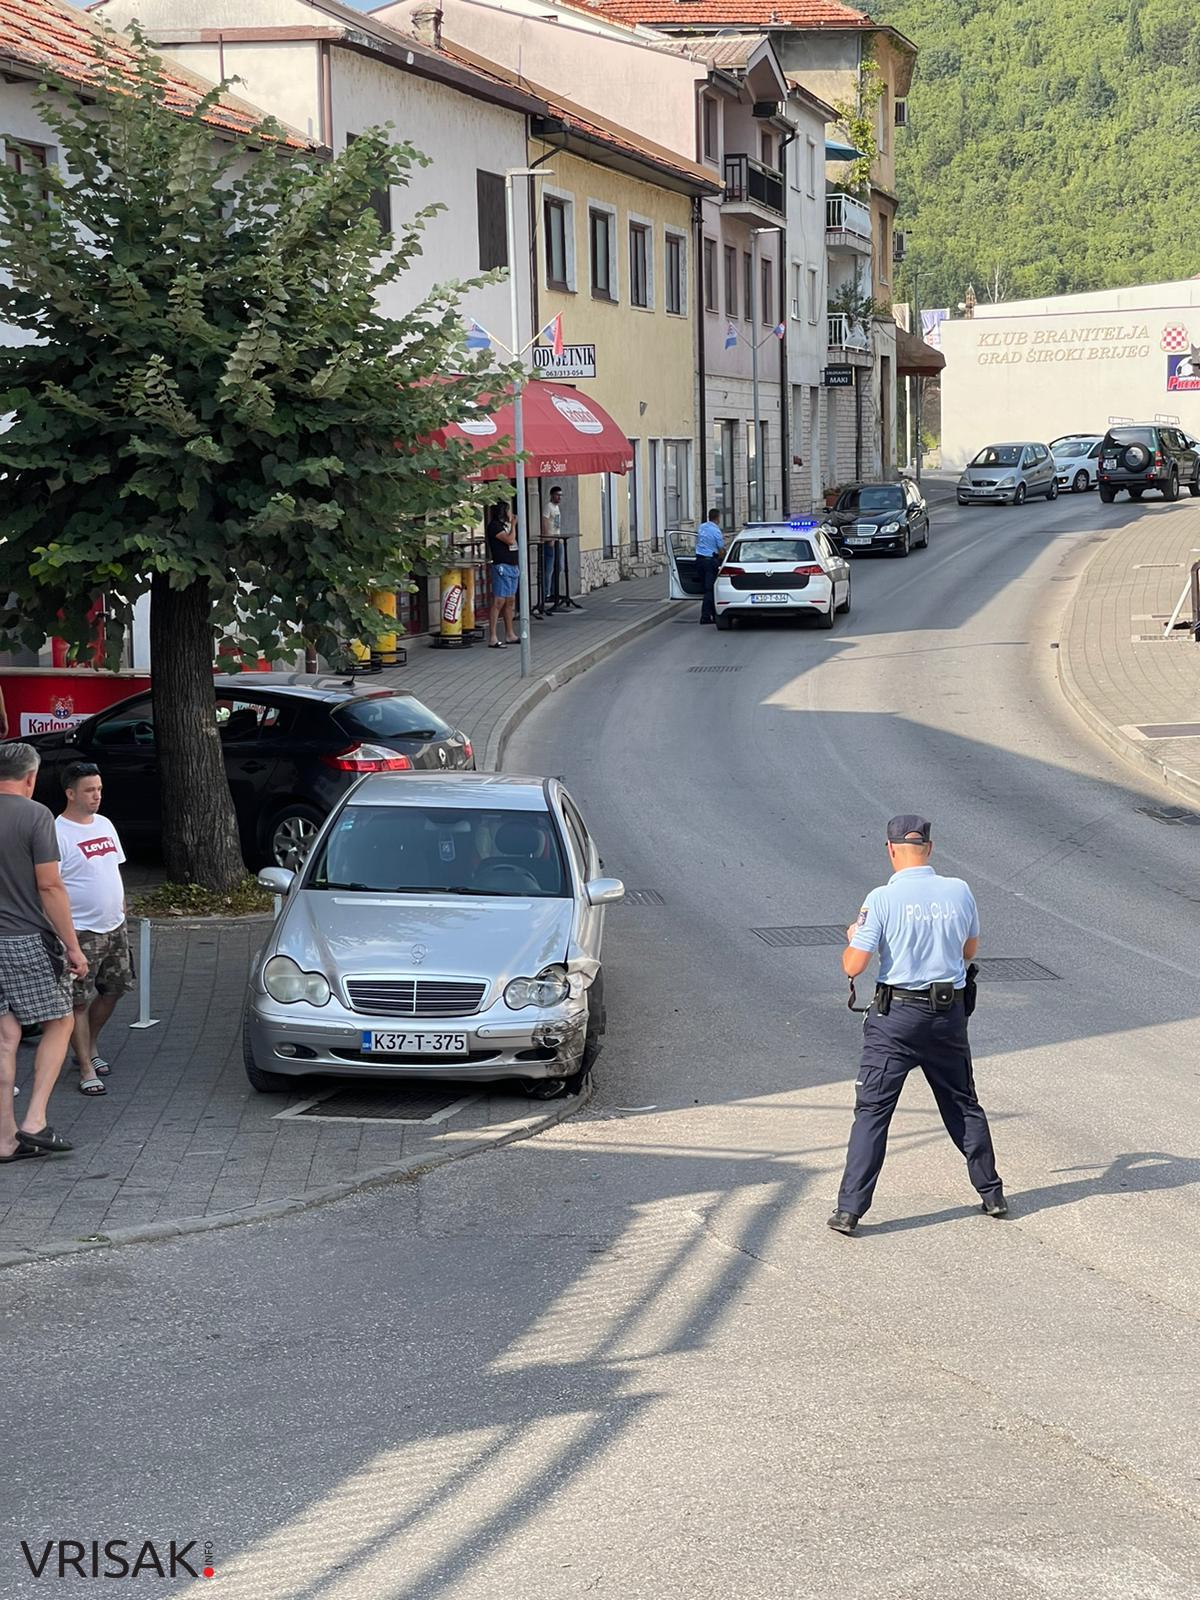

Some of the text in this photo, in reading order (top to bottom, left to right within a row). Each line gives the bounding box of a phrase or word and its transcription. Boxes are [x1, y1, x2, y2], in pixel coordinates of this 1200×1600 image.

[977, 325, 1150, 347] KLUB BRANITELJA
[976, 351, 1022, 366] GRAD
[1087, 344, 1150, 360] BRIJEG
[905, 902, 958, 922] POLICIJA
[374, 1033, 465, 1051] K37-T-375
